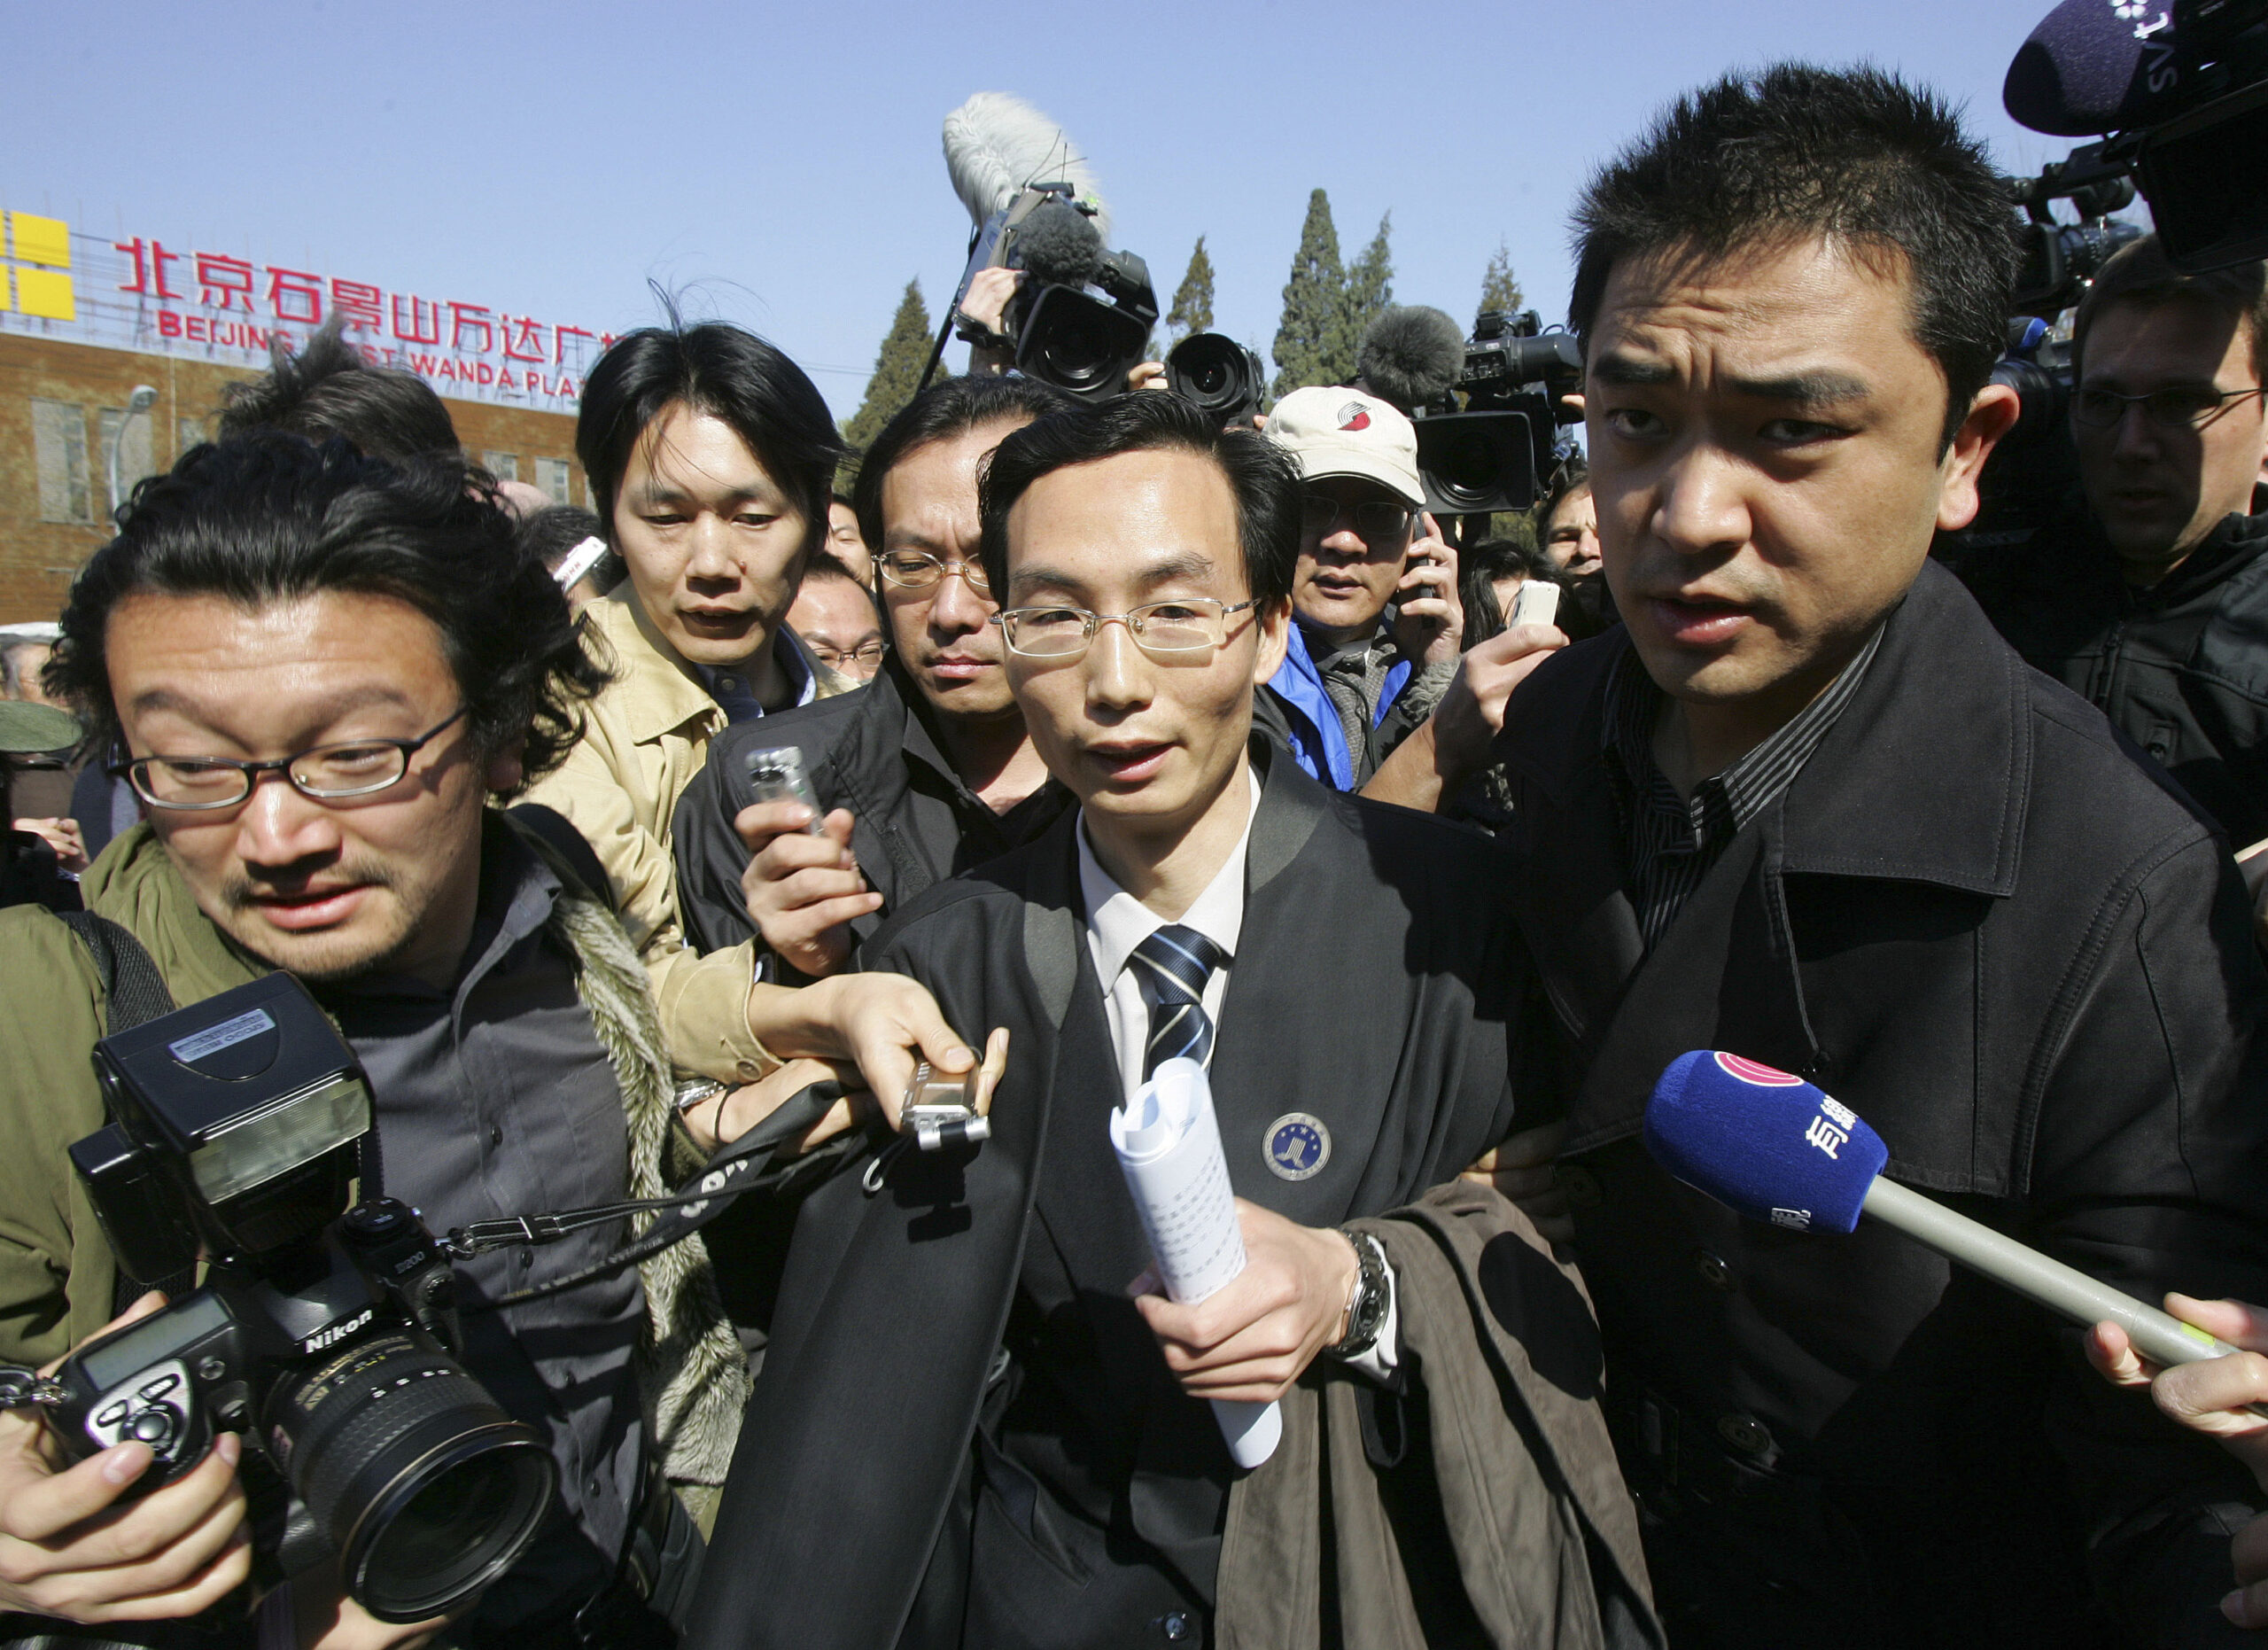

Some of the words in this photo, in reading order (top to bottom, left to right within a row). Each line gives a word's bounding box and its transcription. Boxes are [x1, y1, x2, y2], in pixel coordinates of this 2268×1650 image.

[112, 235, 625, 366] 北京石景山万达广
[408, 352, 515, 389] WANDA
[523, 370, 587, 399] PLA
[306, 1310, 372, 1354] Nikon
